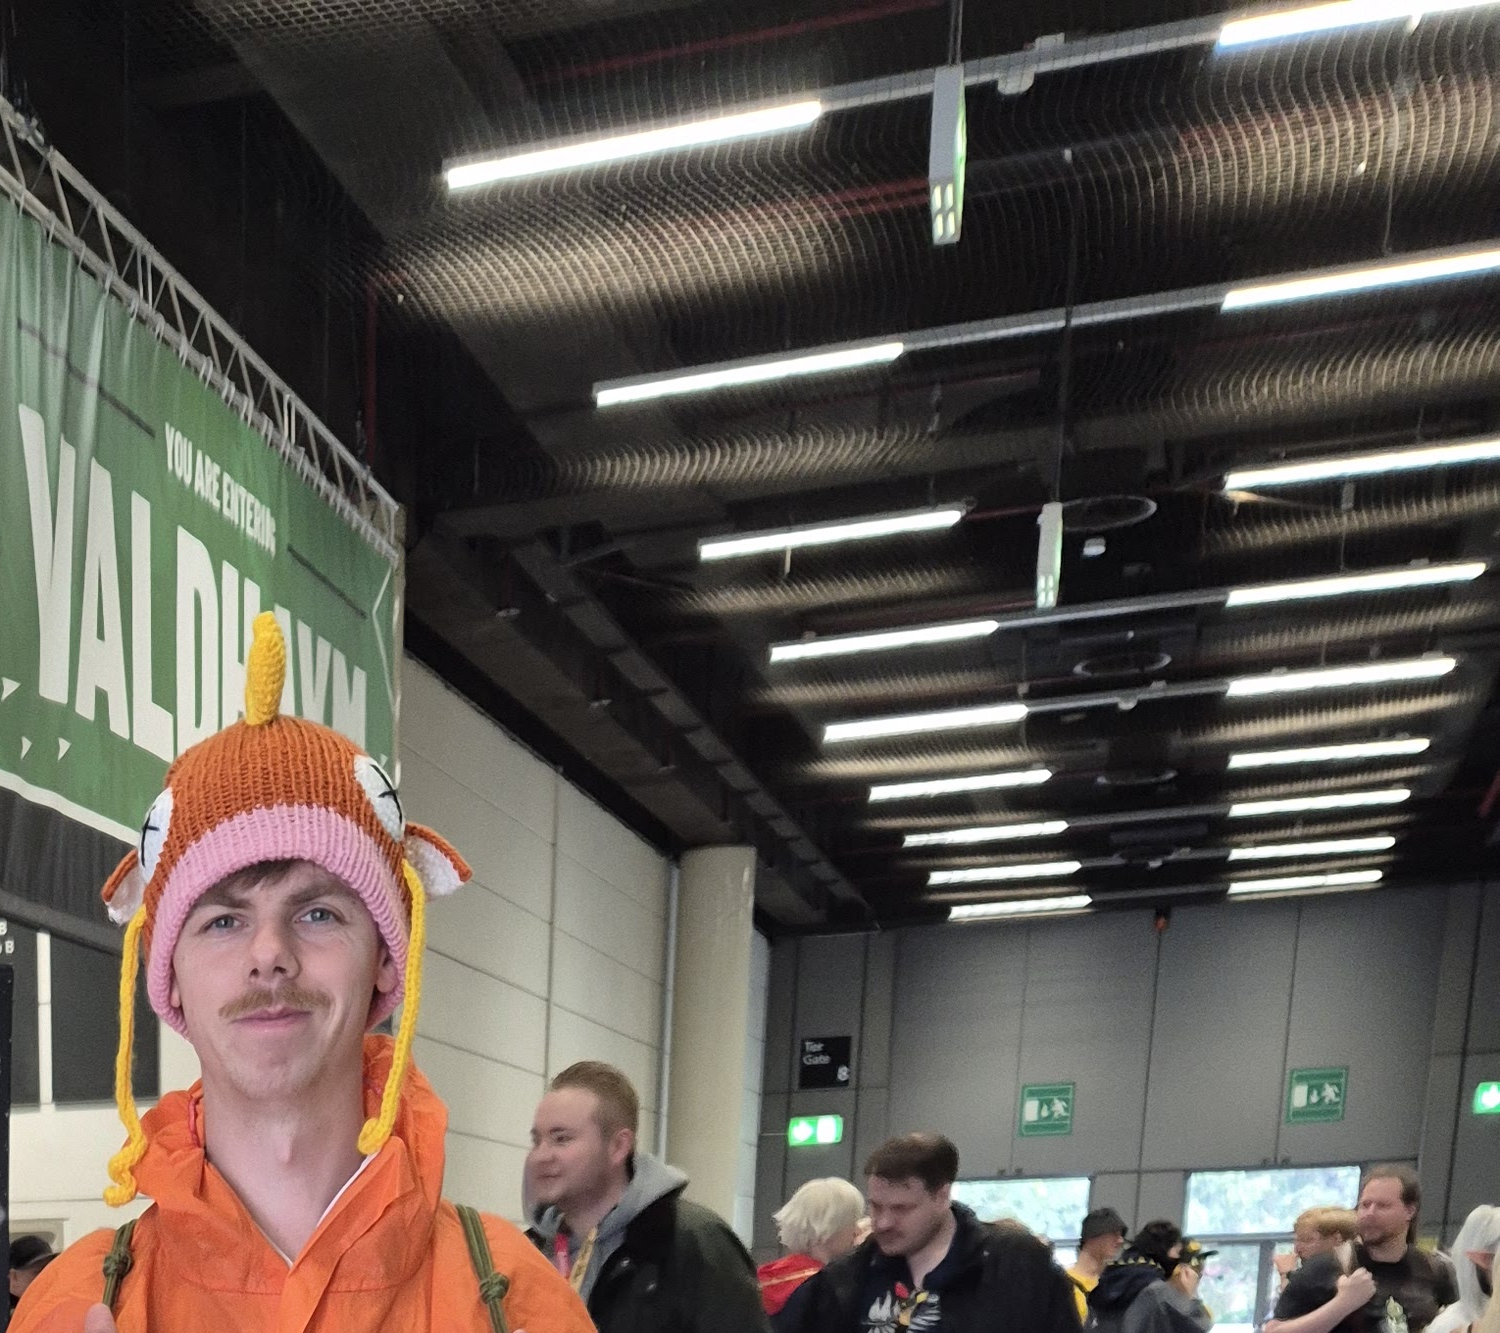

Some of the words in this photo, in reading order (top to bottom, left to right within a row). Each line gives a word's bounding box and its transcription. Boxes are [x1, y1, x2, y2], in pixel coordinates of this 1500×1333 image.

[165, 422, 192, 487] YOU
[194, 449, 221, 511] ARE
[5, 940, 15, 955] B
